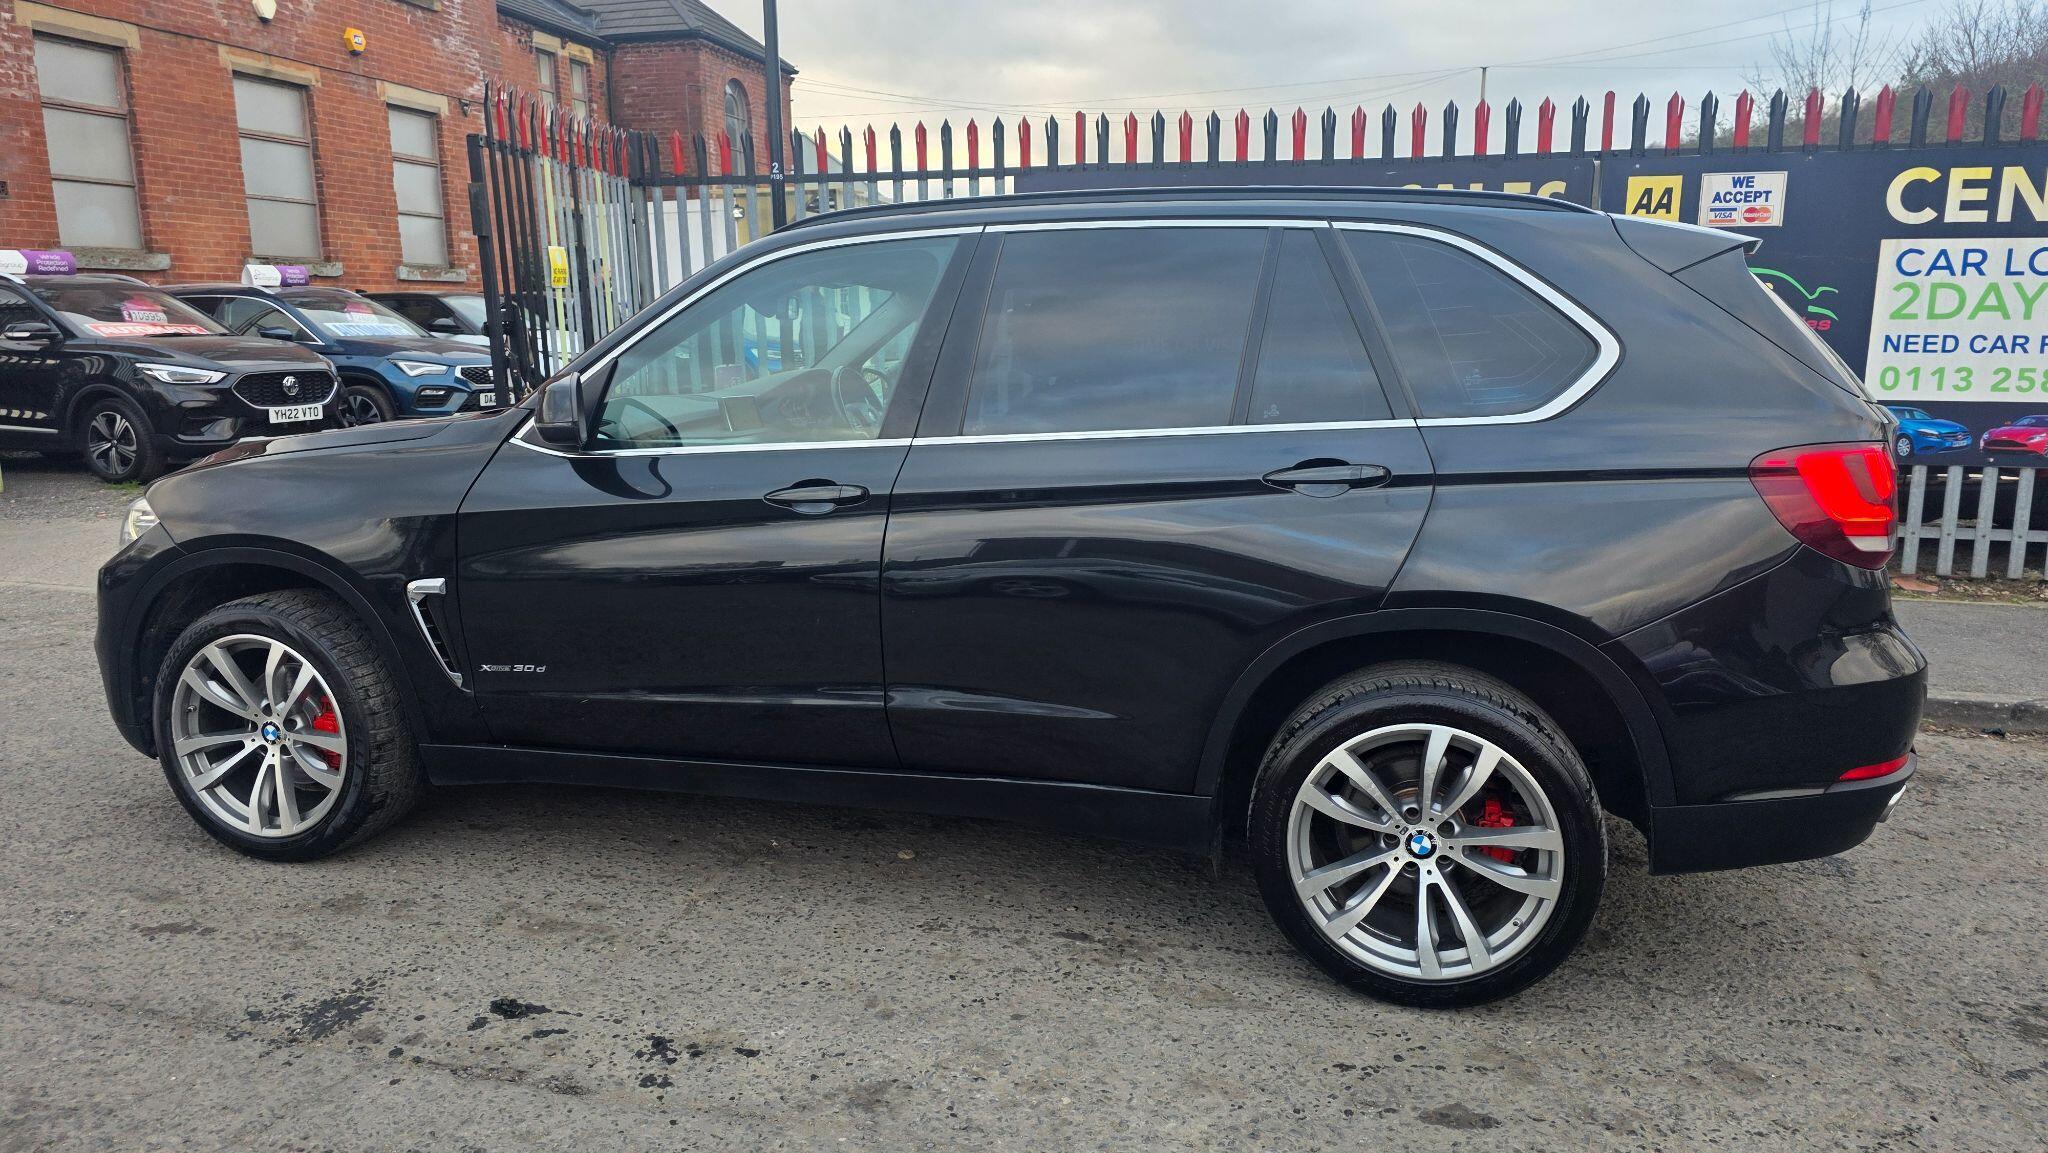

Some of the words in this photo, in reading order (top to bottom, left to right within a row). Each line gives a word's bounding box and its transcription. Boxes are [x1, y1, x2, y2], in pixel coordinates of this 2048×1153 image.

[772, 162, 779, 173] 2
[1732, 176, 1755, 188] WE
[1631, 187, 1673, 215] AA
[1712, 191, 1772, 204] ACCEPT
[1886, 166, 2048, 225] CEN
[1895, 248, 1988, 276] CAR
[1883, 334, 1960, 353] NEED
[1969, 335, 2030, 354] CAR
[1879, 365, 1973, 391] 0113
[274, 408, 299, 421] YH22
[302, 406, 319, 418] VTO
